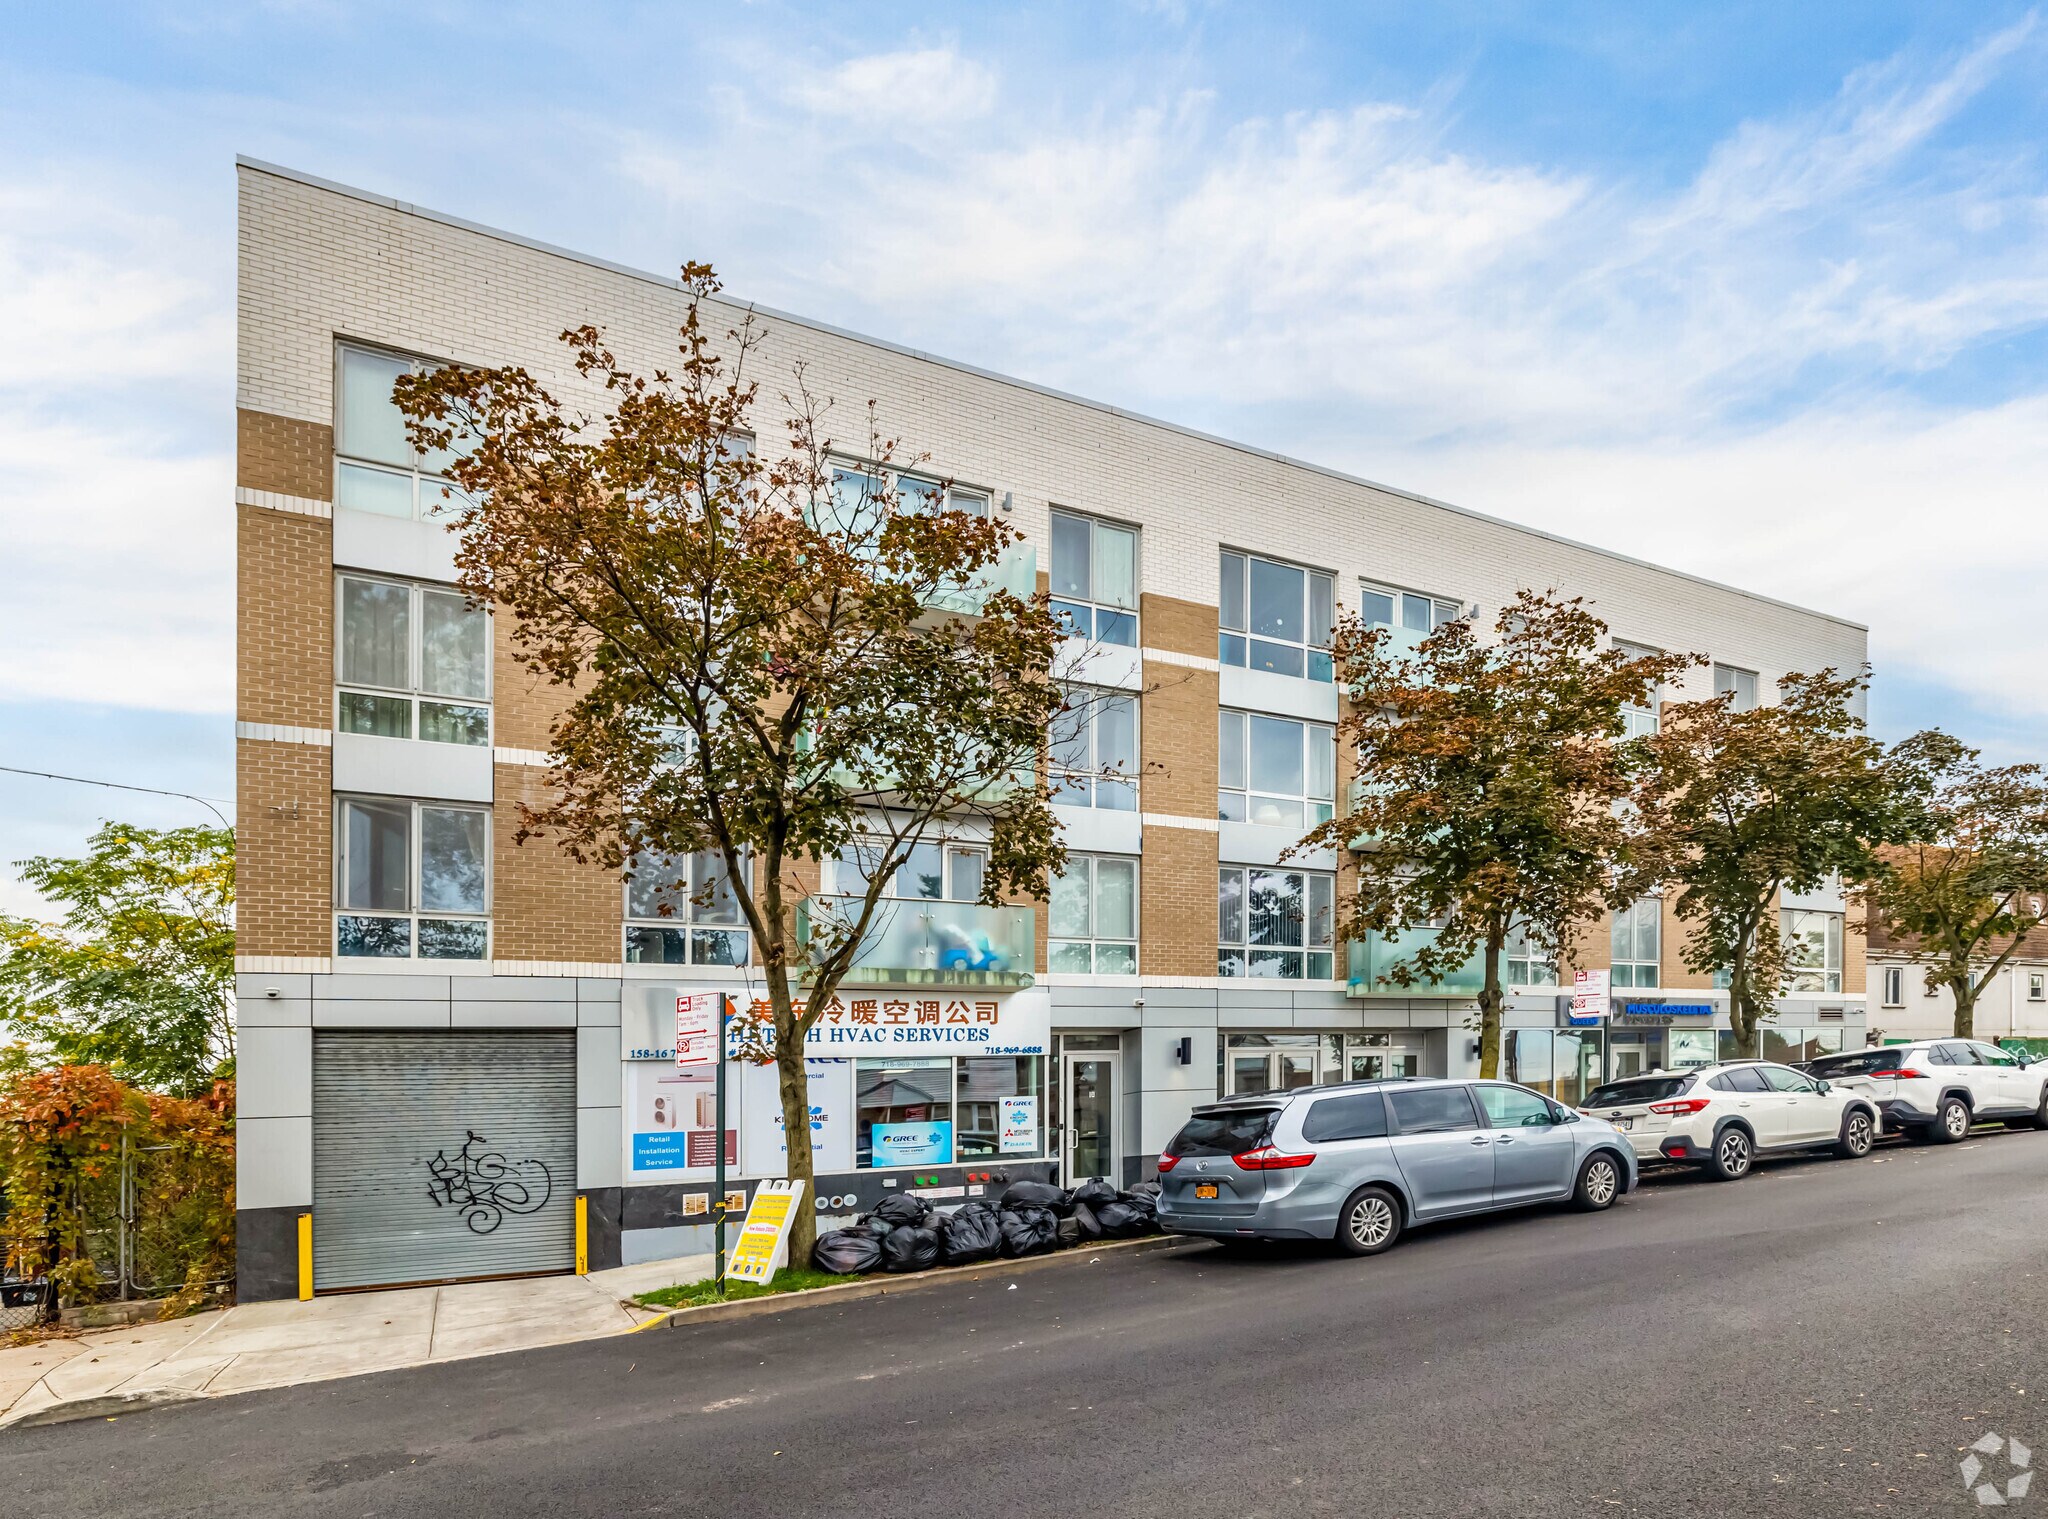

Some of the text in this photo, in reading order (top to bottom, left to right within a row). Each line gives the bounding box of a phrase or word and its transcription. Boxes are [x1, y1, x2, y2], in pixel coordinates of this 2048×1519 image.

[762, 1027, 822, 1043] TH
[829, 1027, 887, 1043] HVAC
[893, 1027, 990, 1043] SERVICES
[630, 1049, 668, 1058] 158-16
[984, 1046, 1043, 1055] 718-969-6888
[880, 1060, 930, 1068] 718-969-7888
[774, 1114, 829, 1124] KIOME
[892, 1134, 919, 1142] GREE
[638, 1147, 680, 1155] Installation
